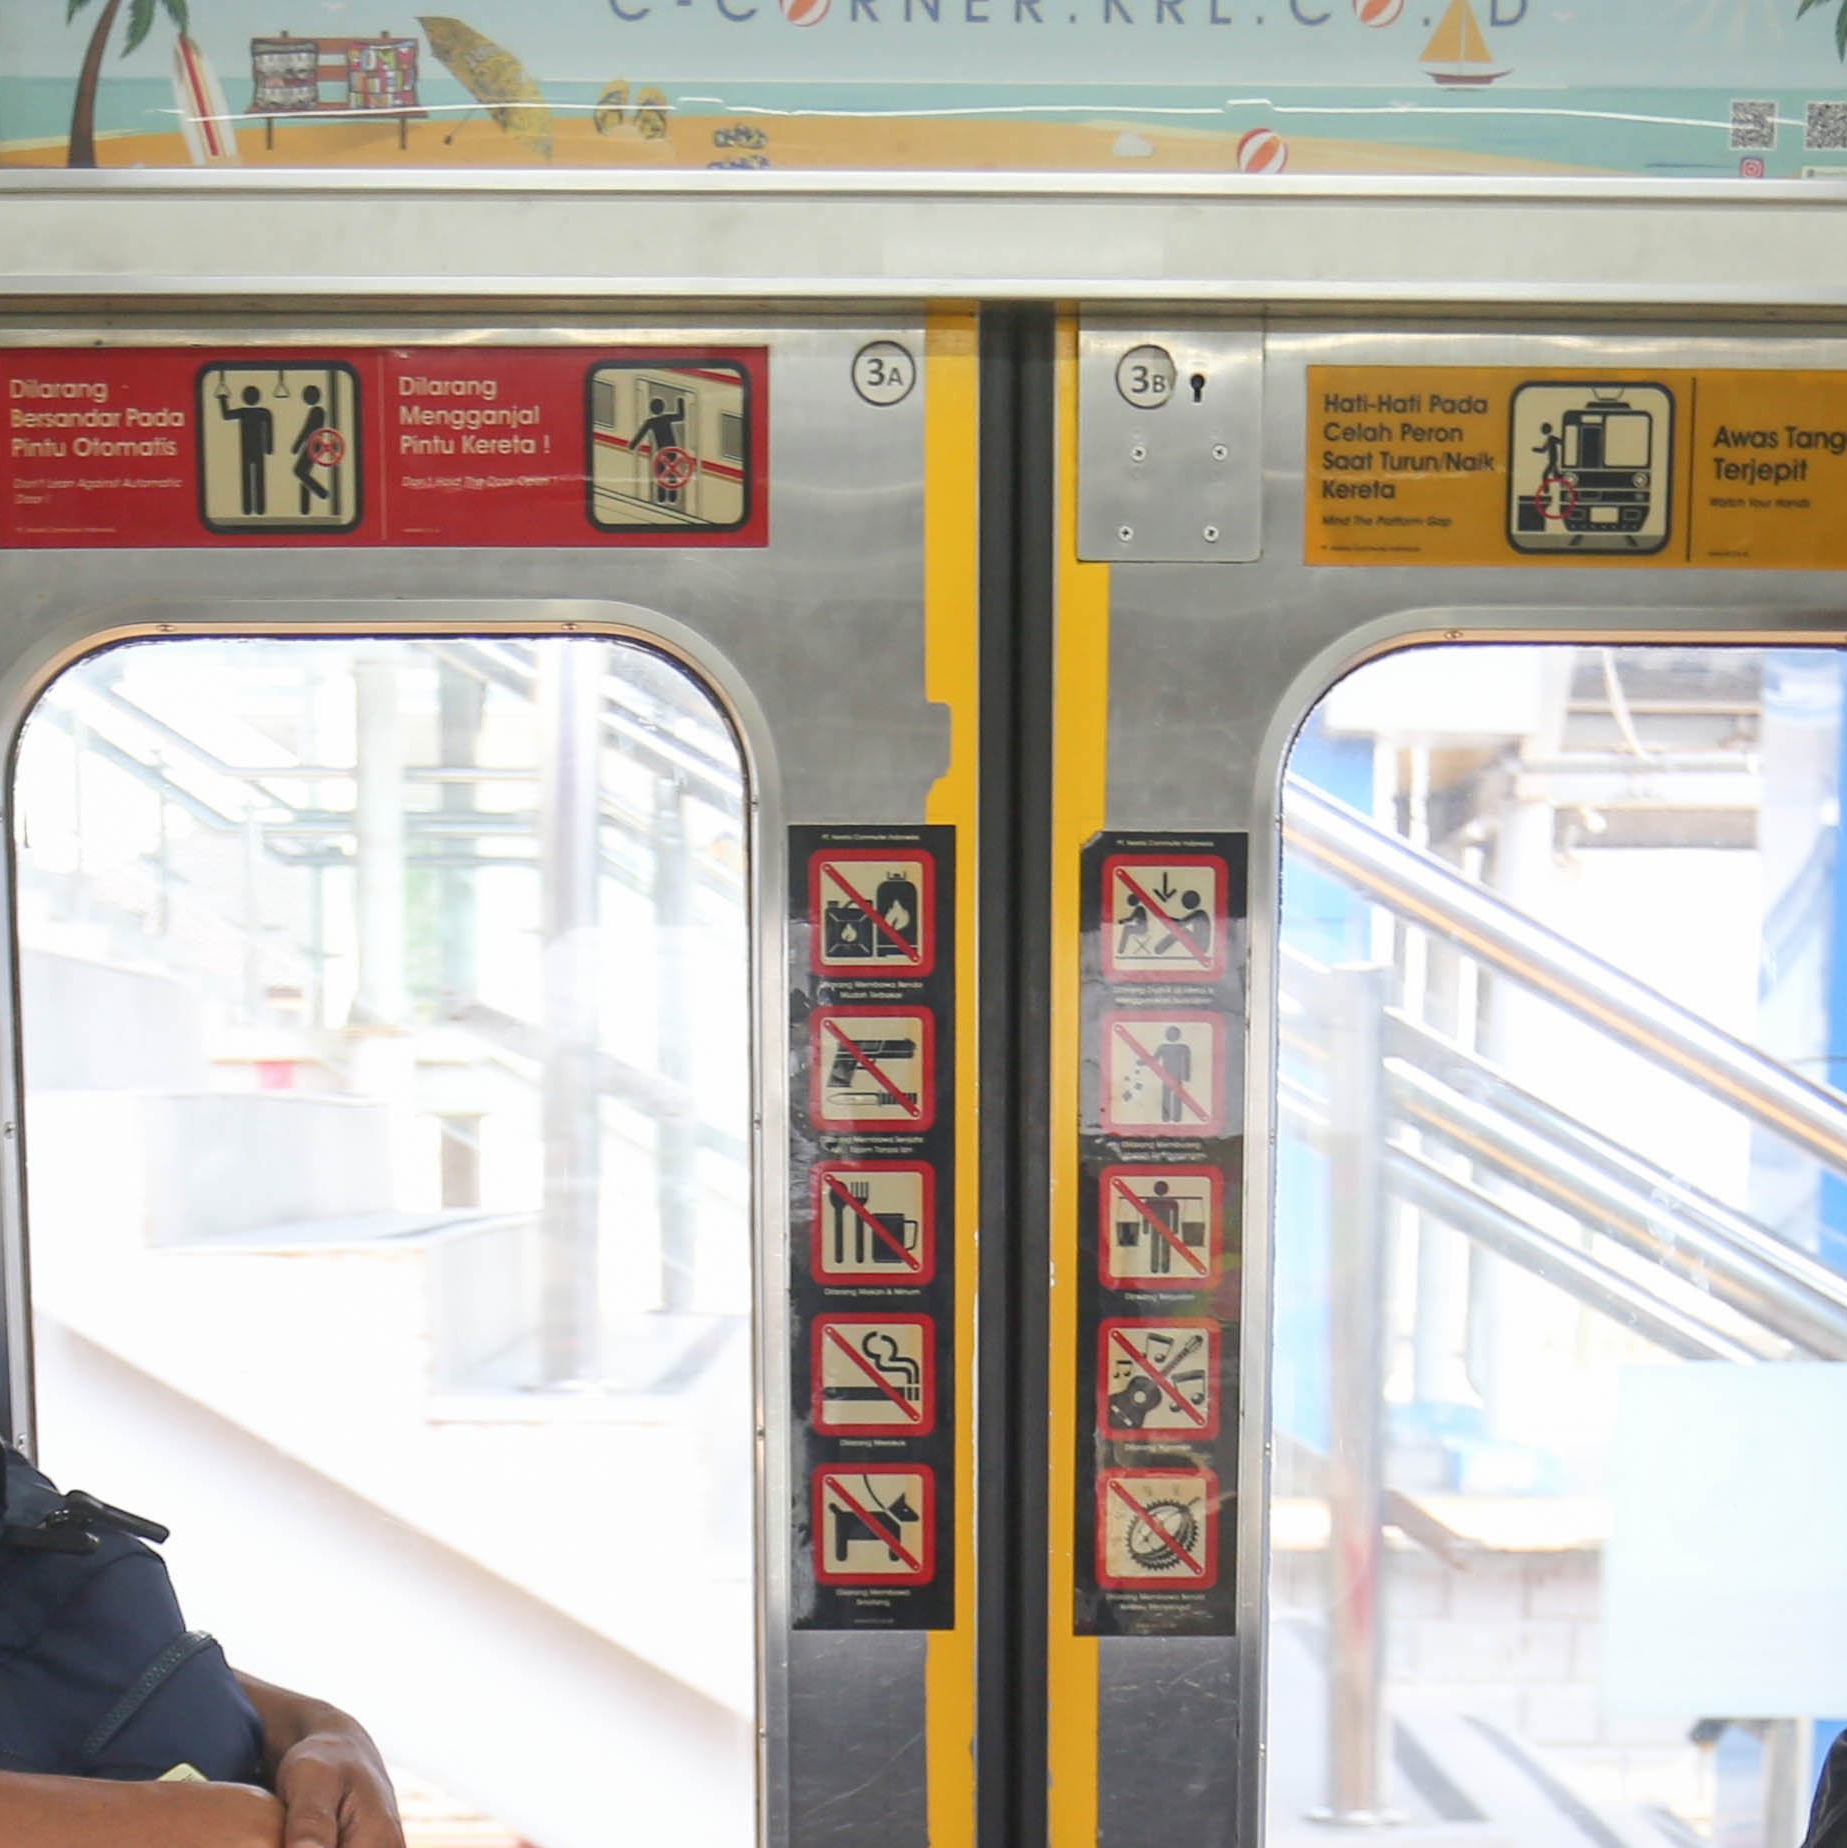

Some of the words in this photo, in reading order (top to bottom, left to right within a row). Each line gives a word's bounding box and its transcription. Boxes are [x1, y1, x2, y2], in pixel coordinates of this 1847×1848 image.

[866, 358, 903, 388] 3A
[1130, 366, 1166, 394] 3B
[9, 379, 108, 403] Dilarang
[398, 376, 497, 400] Dilarang
[1323, 394, 1421, 414] Hati-Hati
[1429, 395, 1489, 414] Pada
[10, 409, 121, 428] Bersandar
[125, 409, 185, 427] Pada
[399, 406, 541, 431] Mengganjal
[1324, 423, 1392, 443] Celah
[1400, 423, 1464, 443] Peron
[1713, 426, 1778, 449] Awas
[11, 438, 66, 457] Pintu
[73, 437, 178, 457] Otomatis
[399, 434, 456, 455] Pintu
[461, 434, 535, 455] Kereta
[1323, 452, 1372, 472] Saat
[1713, 458, 1808, 486] Terjepit
[1322, 480, 1396, 499] Kereta
